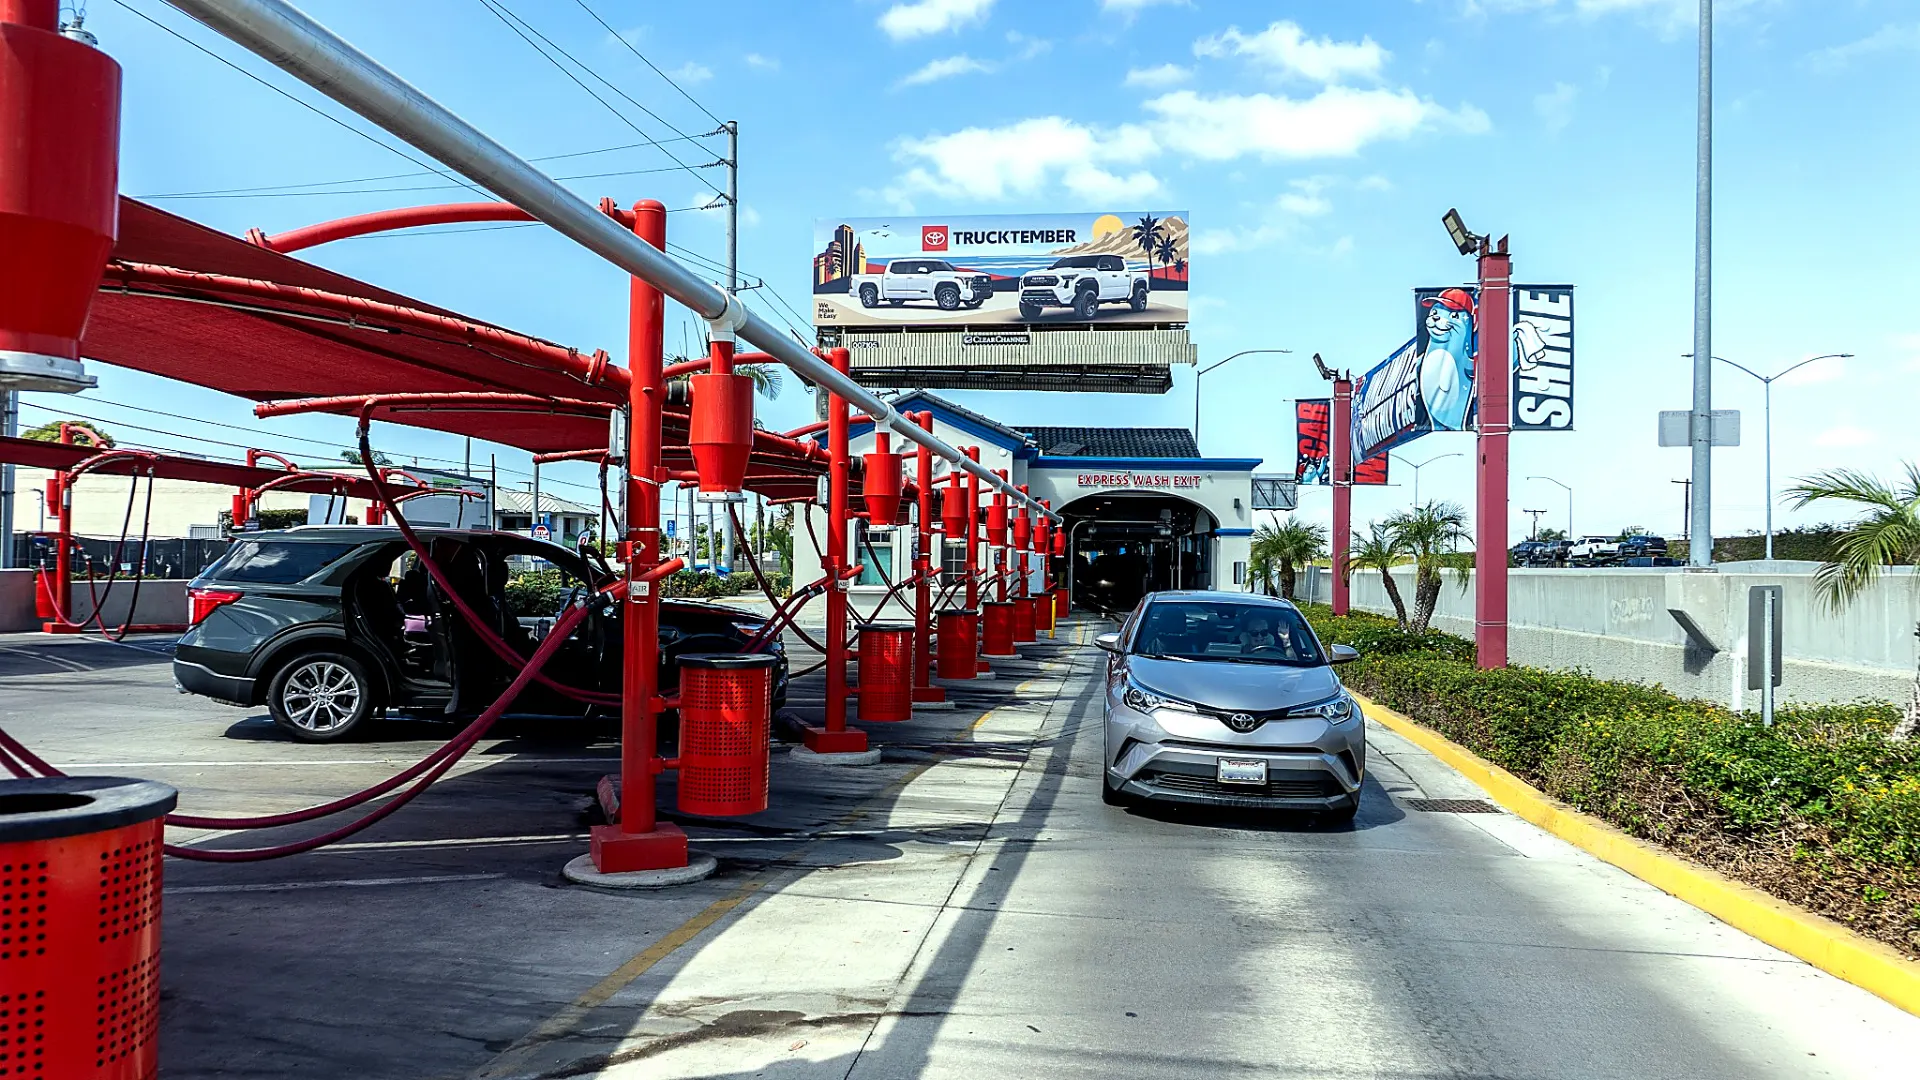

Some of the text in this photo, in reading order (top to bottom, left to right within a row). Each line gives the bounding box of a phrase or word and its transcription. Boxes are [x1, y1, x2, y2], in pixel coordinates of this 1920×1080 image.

[953, 229, 1076, 245] TRUCKTEMBER
[1518, 289, 1572, 429] SHINE
[1396, 381, 1417, 430] PAS
[1297, 402, 1329, 459] CAR
[1077, 474, 1201, 488] EXPRESS WASH EXIT
[632, 585, 647, 593] AIR
